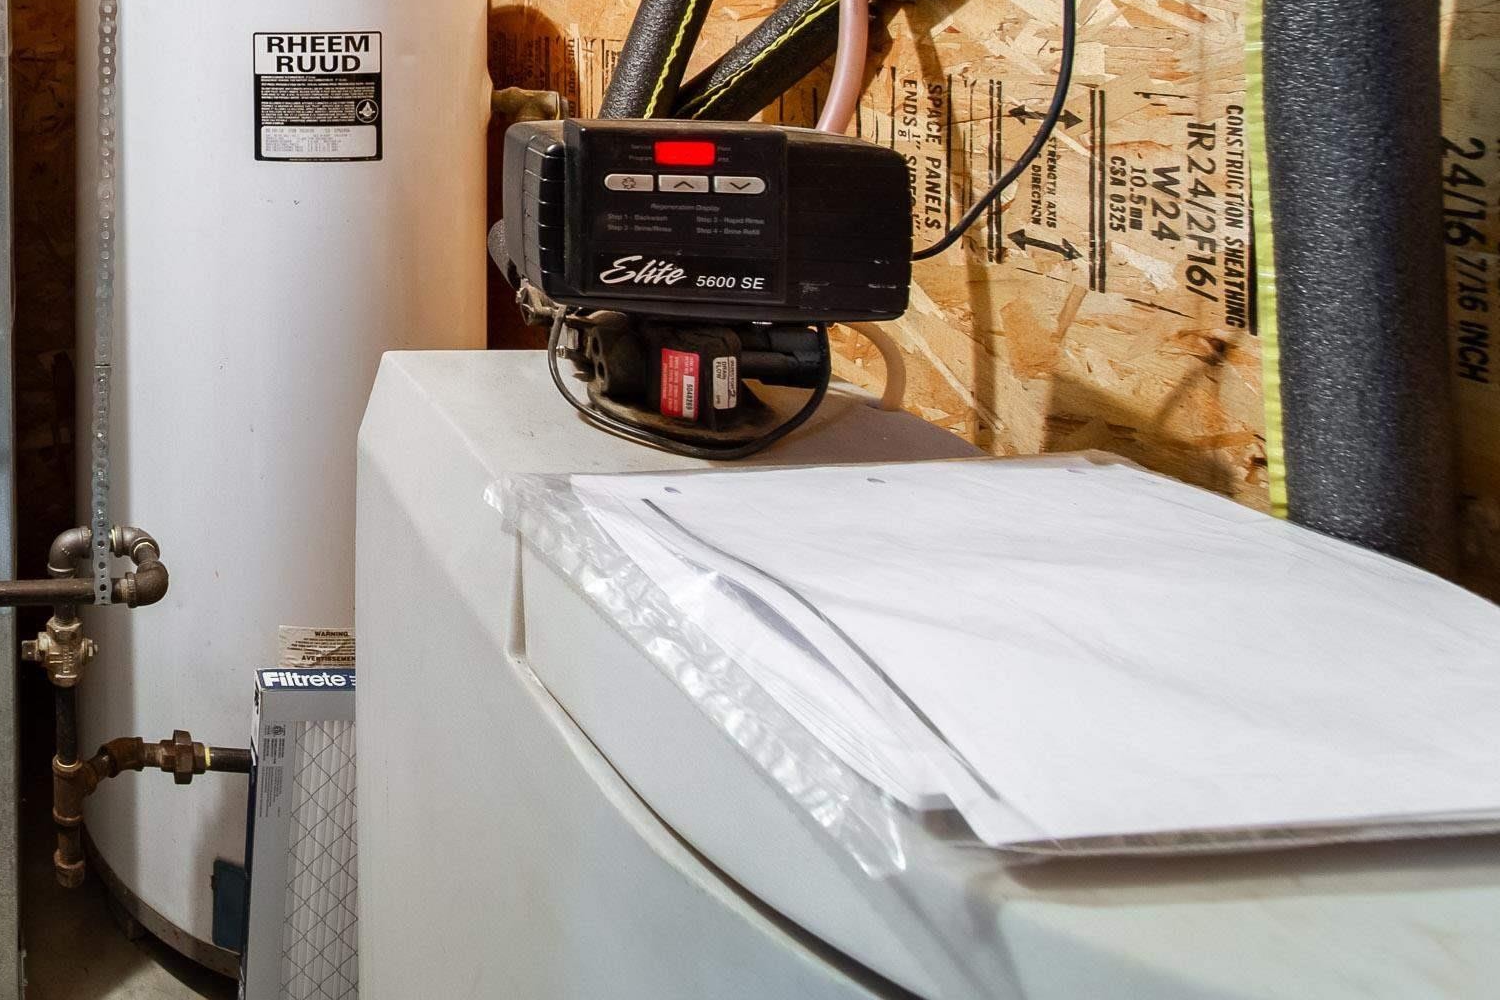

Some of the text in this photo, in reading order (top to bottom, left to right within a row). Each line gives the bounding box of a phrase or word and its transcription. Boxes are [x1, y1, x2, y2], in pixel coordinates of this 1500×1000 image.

[267, 35, 370, 53] RHEEM
[276, 55, 361, 73] RUUD
[902, 79, 918, 128] ENDS
[924, 82, 943, 230] SPACE PANELS
[1108, 155, 1127, 187] CSA
[1045, 136, 1057, 229] STRENGTH AXIS
[1150, 165, 1181, 242] W24
[1223, 104, 1246, 329] CONSTRUCTION SHEATHING
[599, 255, 766, 290] Elite 5600 SE
[1440, 135, 1490, 385] 24/16 7/16 INCH
[262, 671, 347, 688] Filtrete
